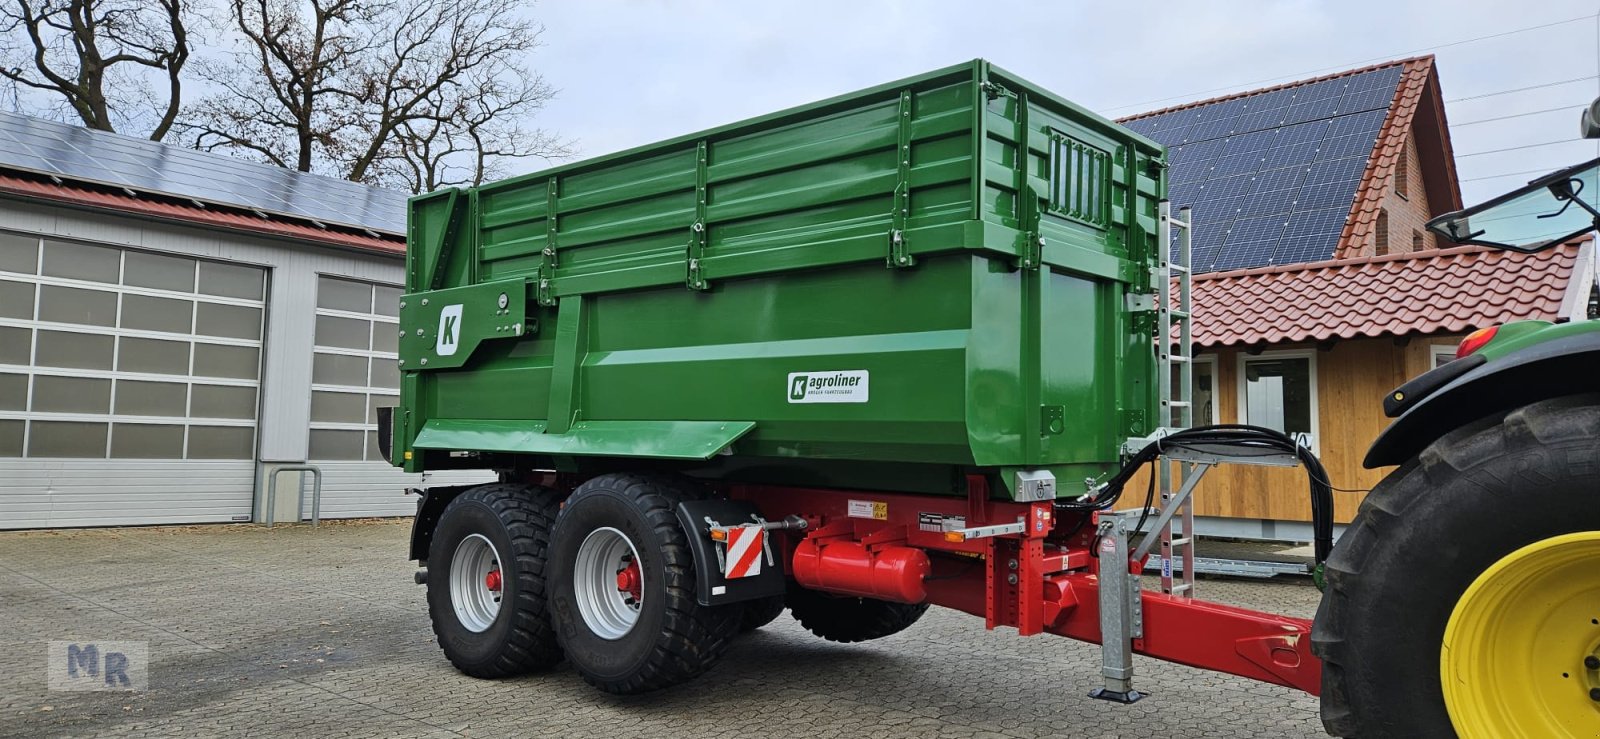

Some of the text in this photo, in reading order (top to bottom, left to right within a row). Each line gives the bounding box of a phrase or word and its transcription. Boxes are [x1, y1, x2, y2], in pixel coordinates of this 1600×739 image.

[442, 315, 457, 345] K
[793, 380, 805, 396] K
[809, 373, 862, 390] agroliner
